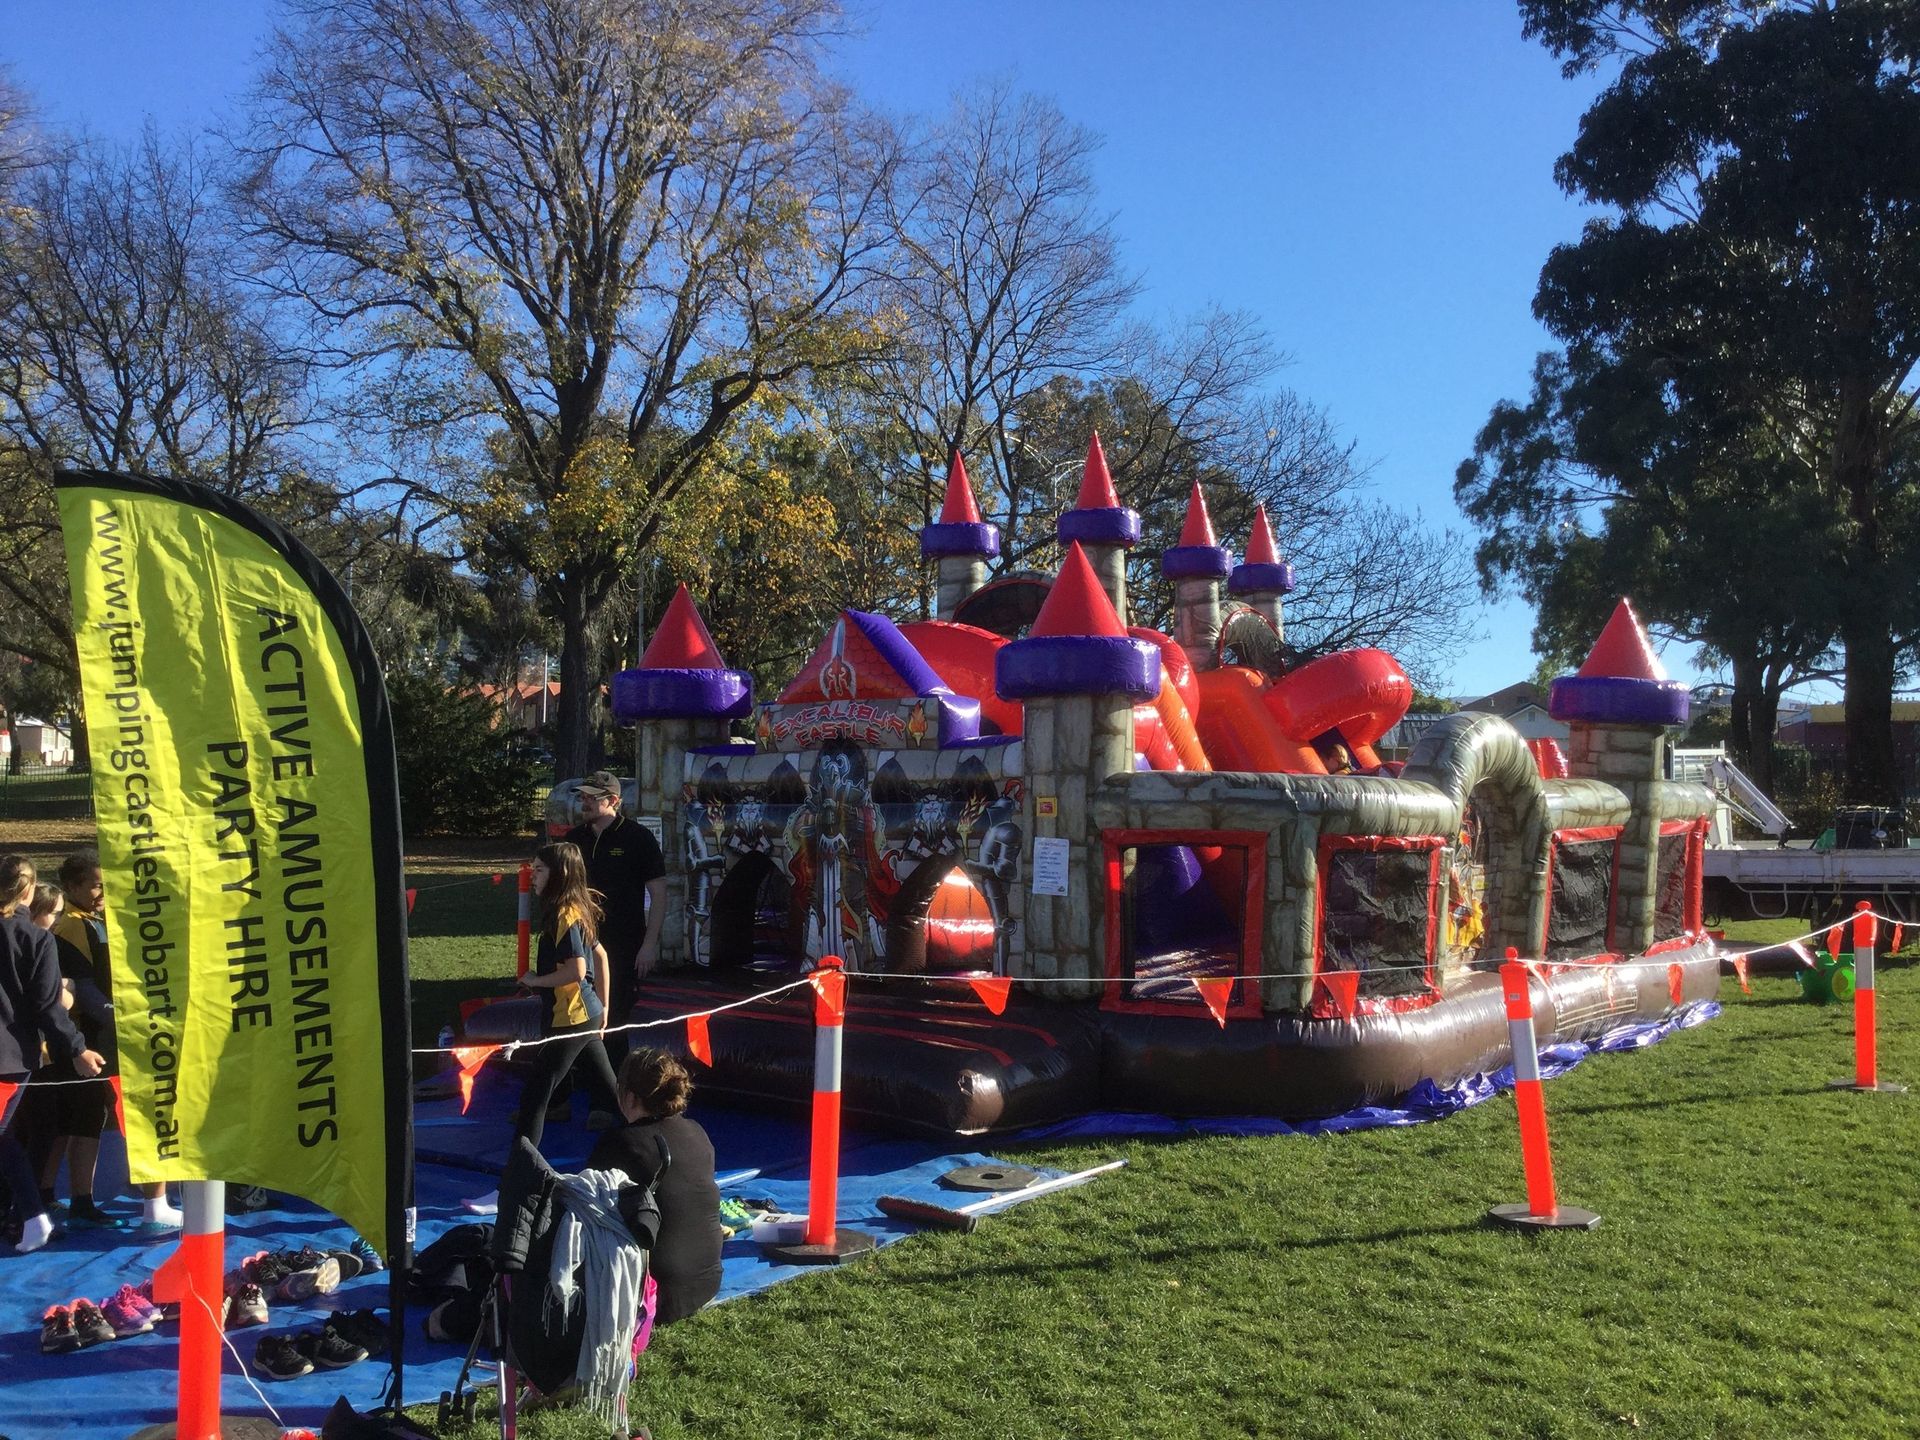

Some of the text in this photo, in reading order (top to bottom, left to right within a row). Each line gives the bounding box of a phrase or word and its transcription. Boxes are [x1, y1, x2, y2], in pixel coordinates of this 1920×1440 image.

[95, 510, 180, 1162] www.jumpingcastleshobart.com.au
[773, 702, 906, 739] EXCALIBUR
[795, 720, 881, 746] CASTLE
[206, 740, 273, 1032] PARTY HIRE
[256, 605, 338, 1148] ACTIVE AMUSEMENTS
